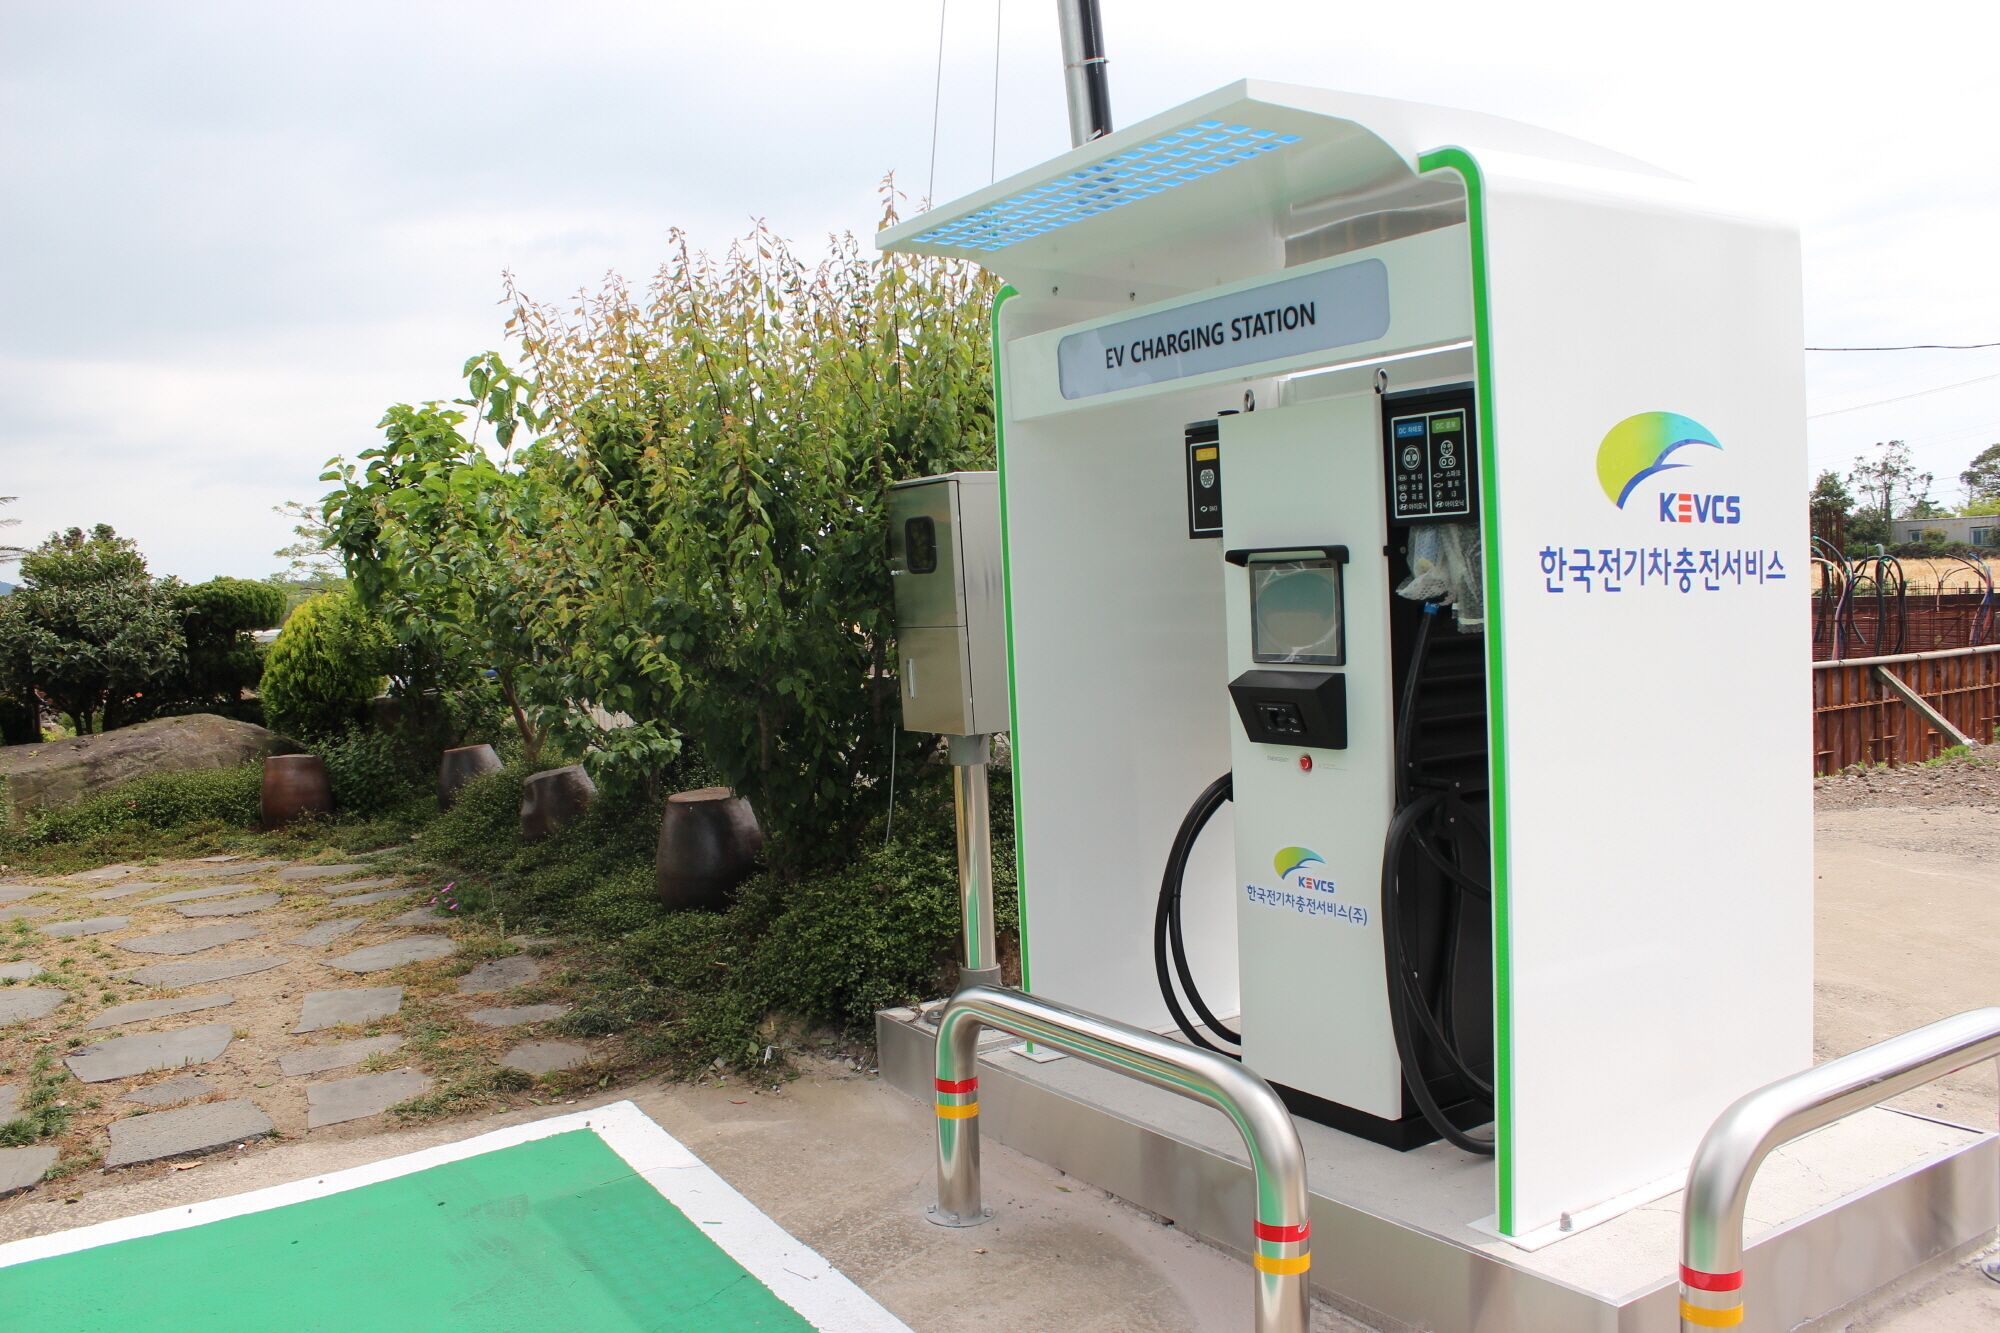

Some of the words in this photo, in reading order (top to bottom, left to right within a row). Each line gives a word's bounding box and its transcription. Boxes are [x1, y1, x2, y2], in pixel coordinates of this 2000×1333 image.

[1105, 345, 1125, 369] EV
[1130, 321, 1225, 363] CHARGING
[1231, 301, 1317, 342] STATION
[1659, 492, 1741, 524] KEVCS
[1538, 545, 1786, 594] 한국전기차충전서비스
[1246, 884, 1368, 926] 한국전기차충전서비스(주)
[1298, 876, 1335, 894] KEVCS
